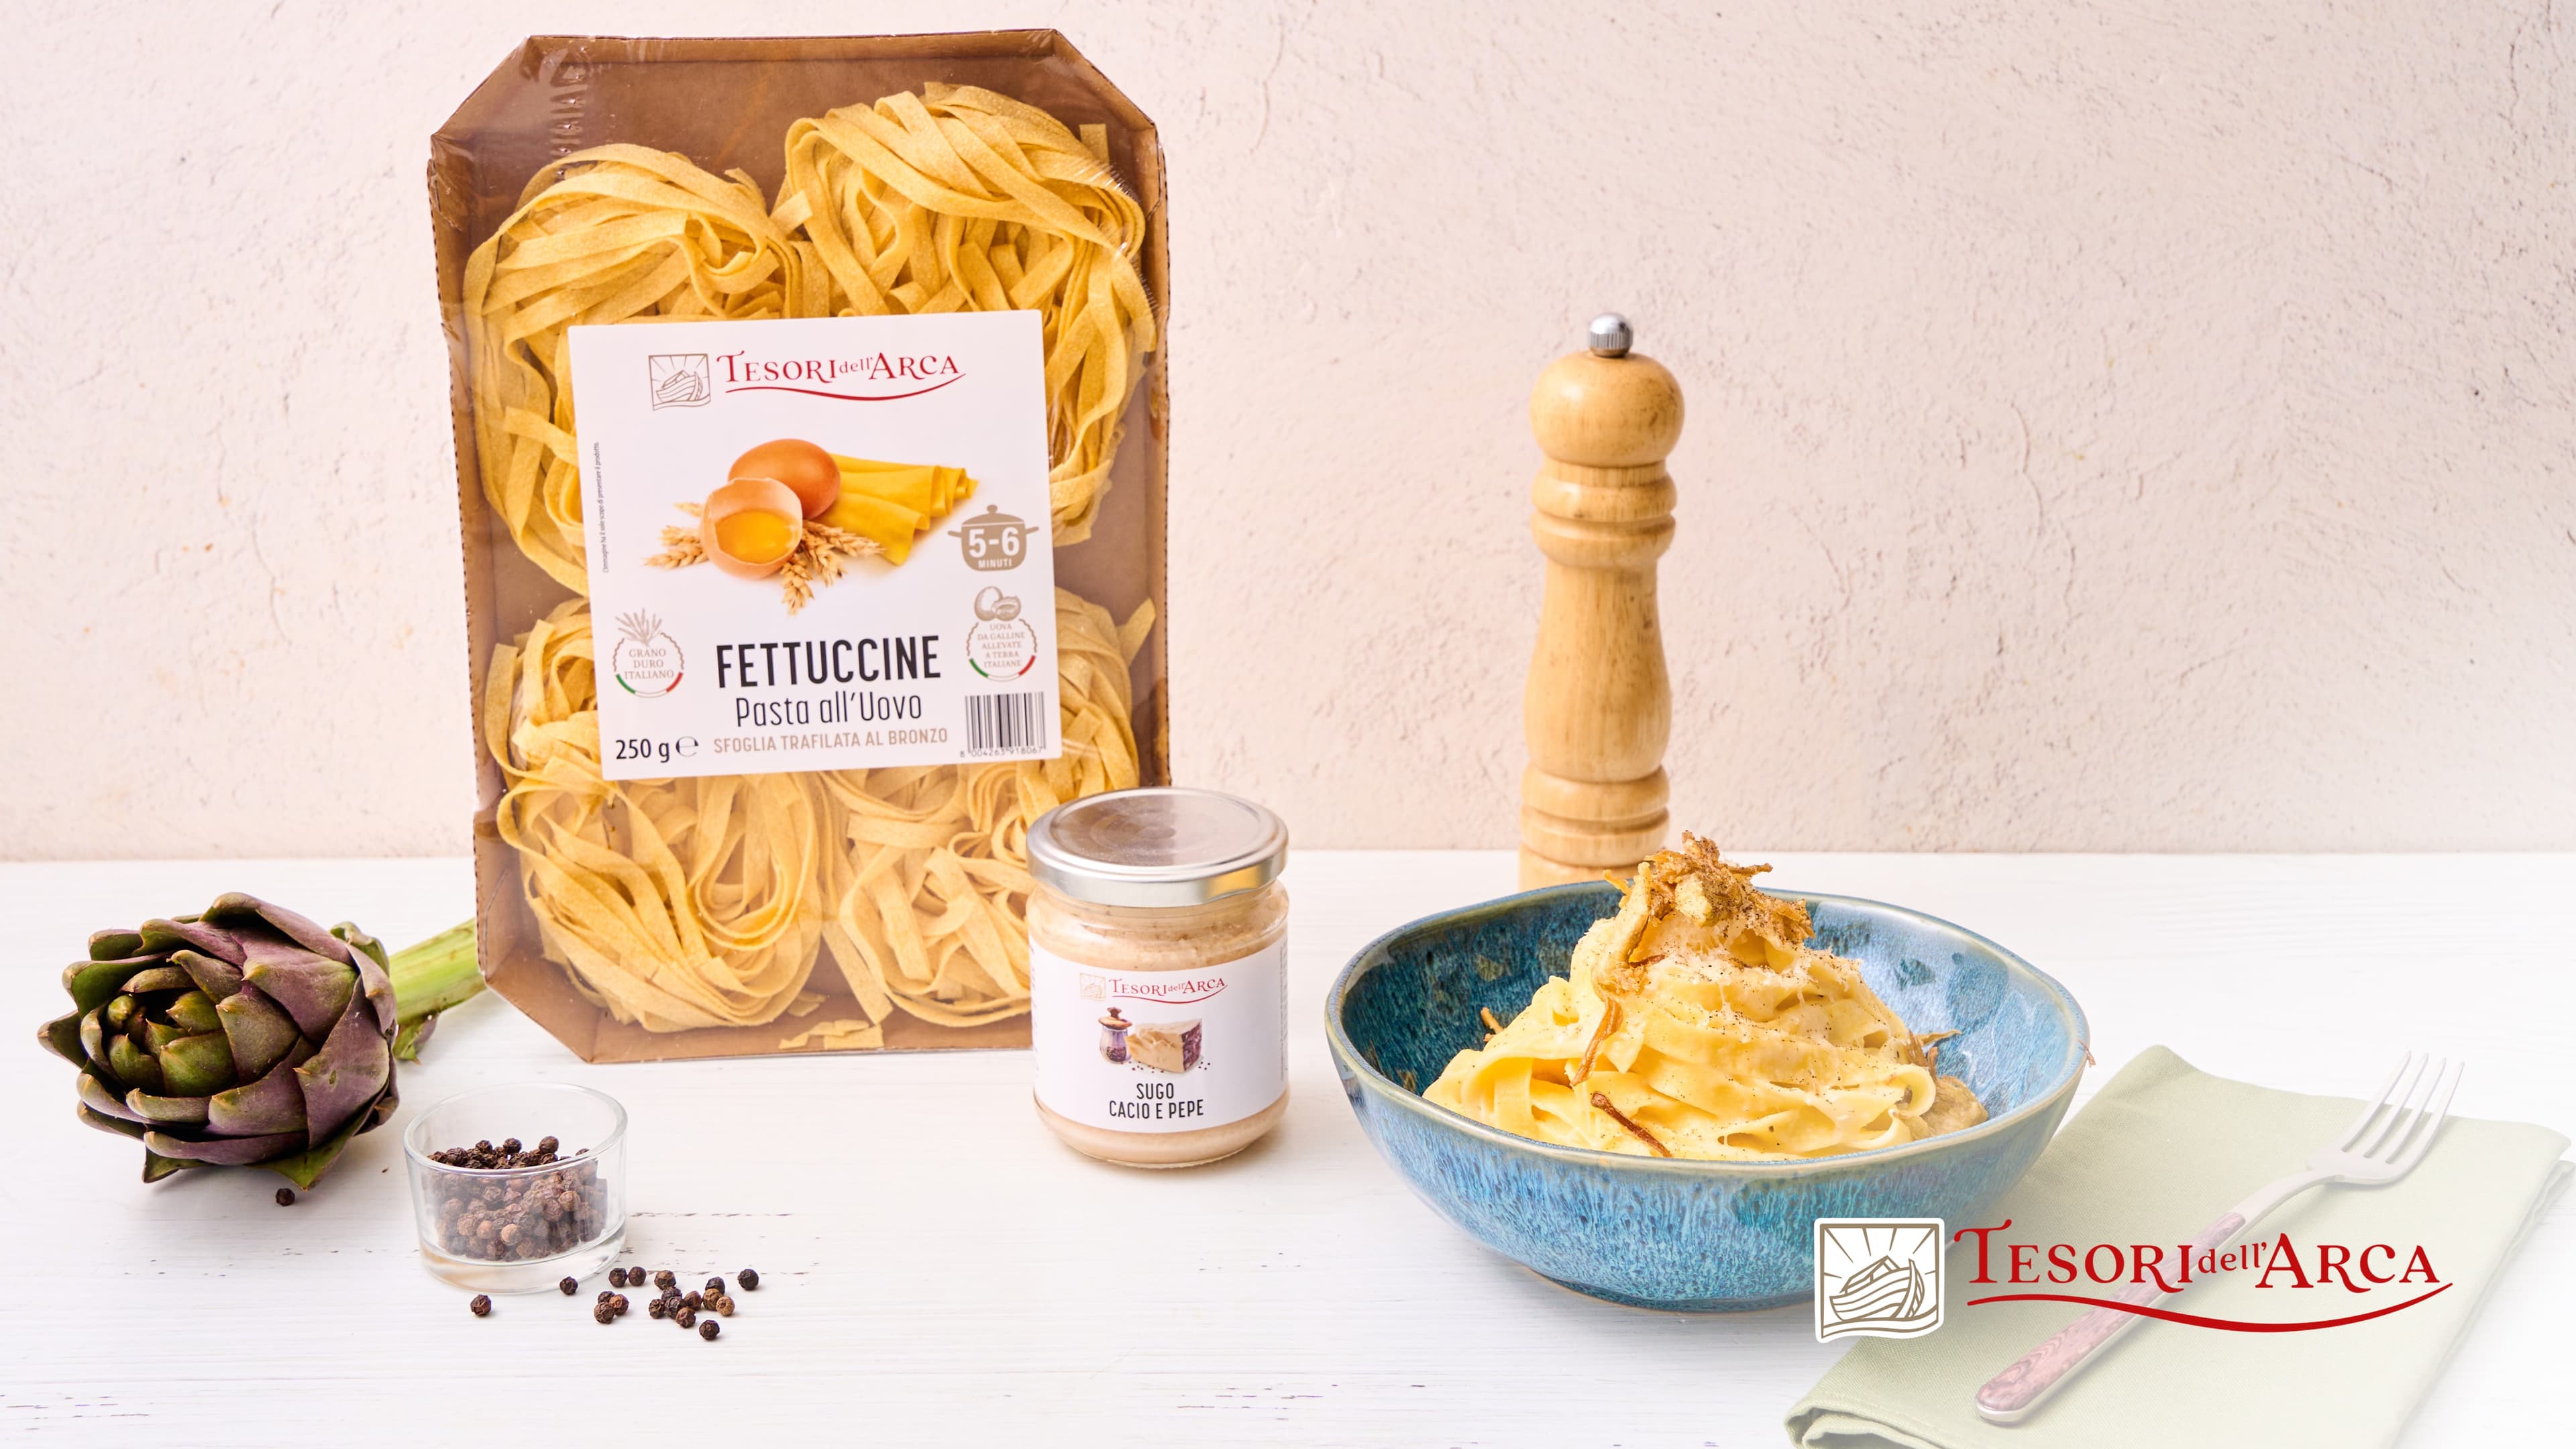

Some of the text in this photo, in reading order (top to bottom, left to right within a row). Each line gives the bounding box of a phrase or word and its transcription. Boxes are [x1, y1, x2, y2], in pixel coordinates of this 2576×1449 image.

[716, 350, 836, 383] TESORI
[969, 527, 1020, 558] 5-6
[978, 558, 1012, 568] MINUTI
[629, 649, 666, 657] GRANO
[982, 641, 1022, 649] ALLEVATE
[633, 659, 663, 668] DURO
[716, 635, 941, 688] FETTUCCINE
[625, 669, 674, 680] ITALIANO
[736, 690, 922, 727] Pasta all'Uovo
[714, 728, 948, 753] SFOGLIA TRAFILATA AL BRONZO
[616, 739, 651, 759] 250
[658, 742, 670, 763] g
[1109, 978, 1168, 996] TESORI
[1136, 1083, 1174, 1099] SUGO
[1110, 1099, 1204, 1119] CACIO E PEPE
